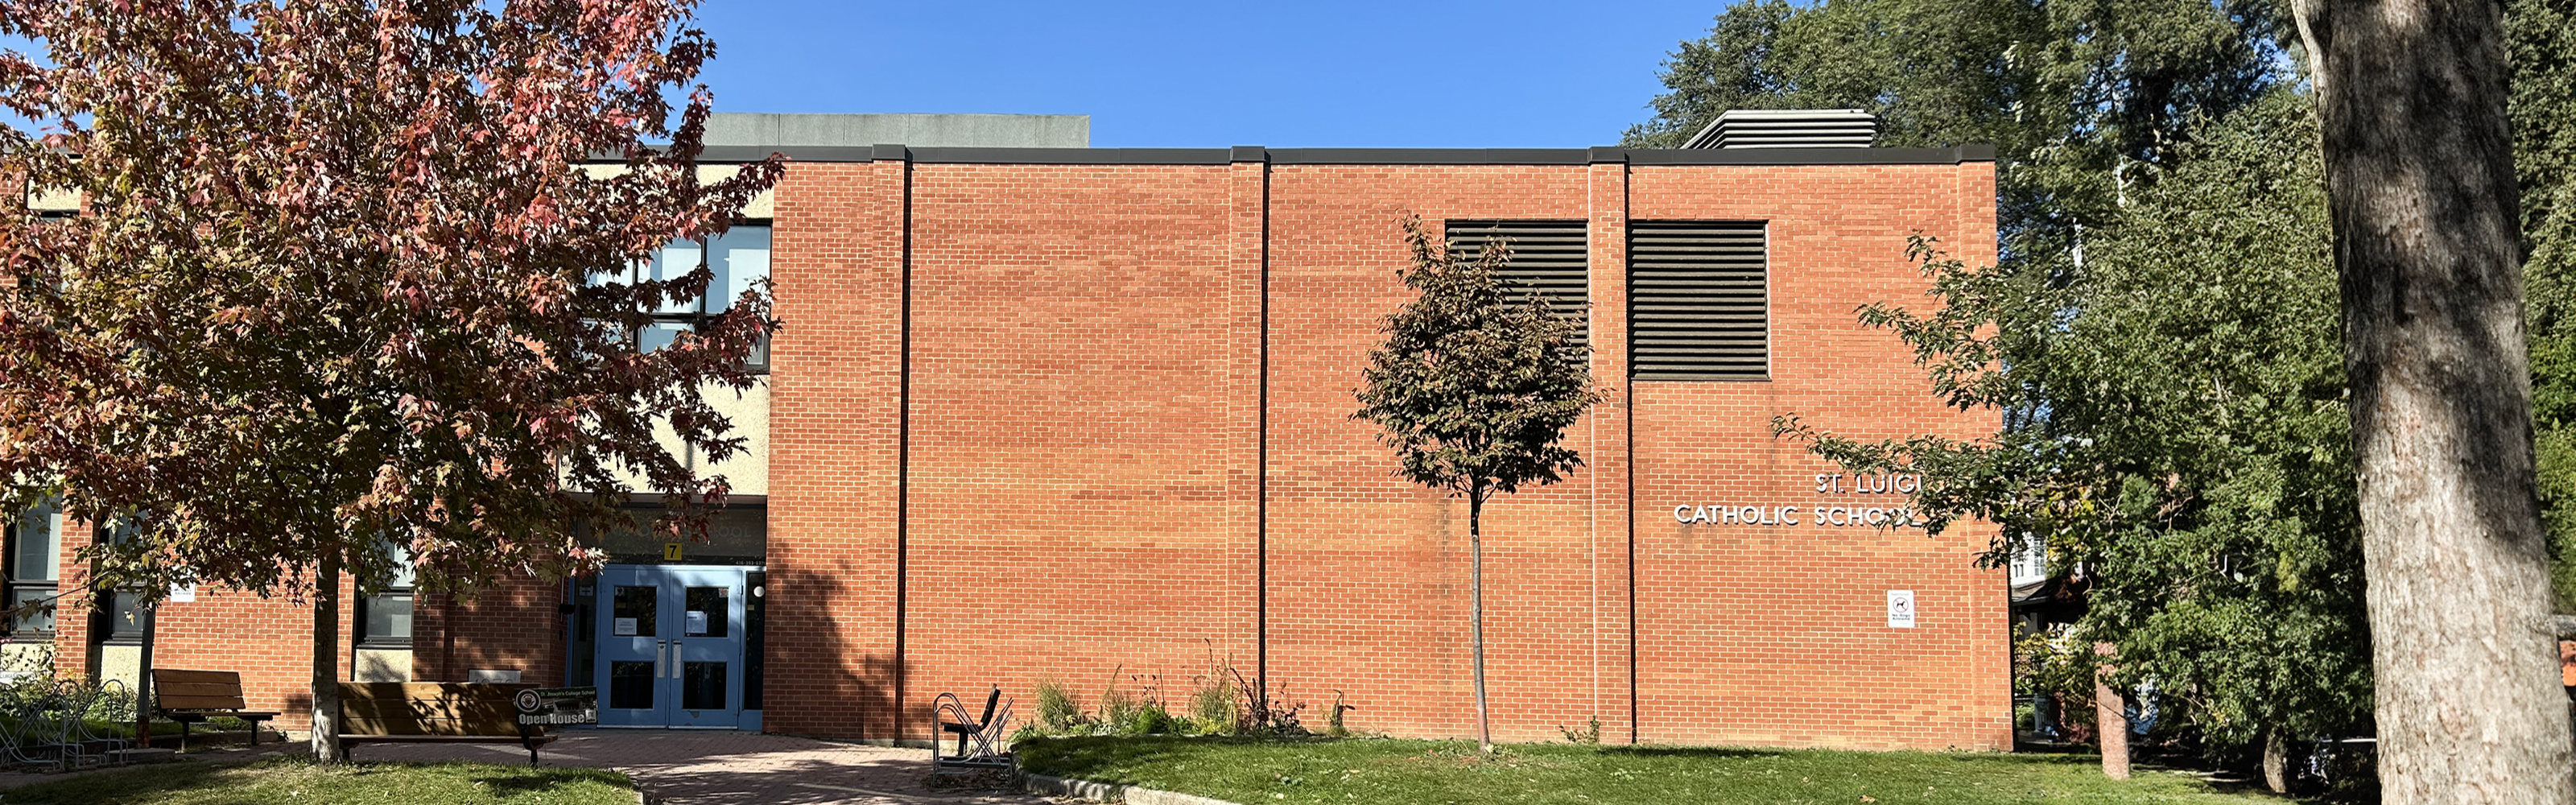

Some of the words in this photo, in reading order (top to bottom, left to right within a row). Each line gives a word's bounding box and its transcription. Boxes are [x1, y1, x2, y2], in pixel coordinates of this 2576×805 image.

[1815, 473, 1845, 493] ST.
[1856, 473, 1922, 493] LUIGI
[1674, 504, 1798, 526] CATHOLIC
[1814, 506, 1922, 527] SCHOOL
[669, 545, 678, 559] 7
[519, 713, 548, 725] Open
[550, 713, 585, 724] House
